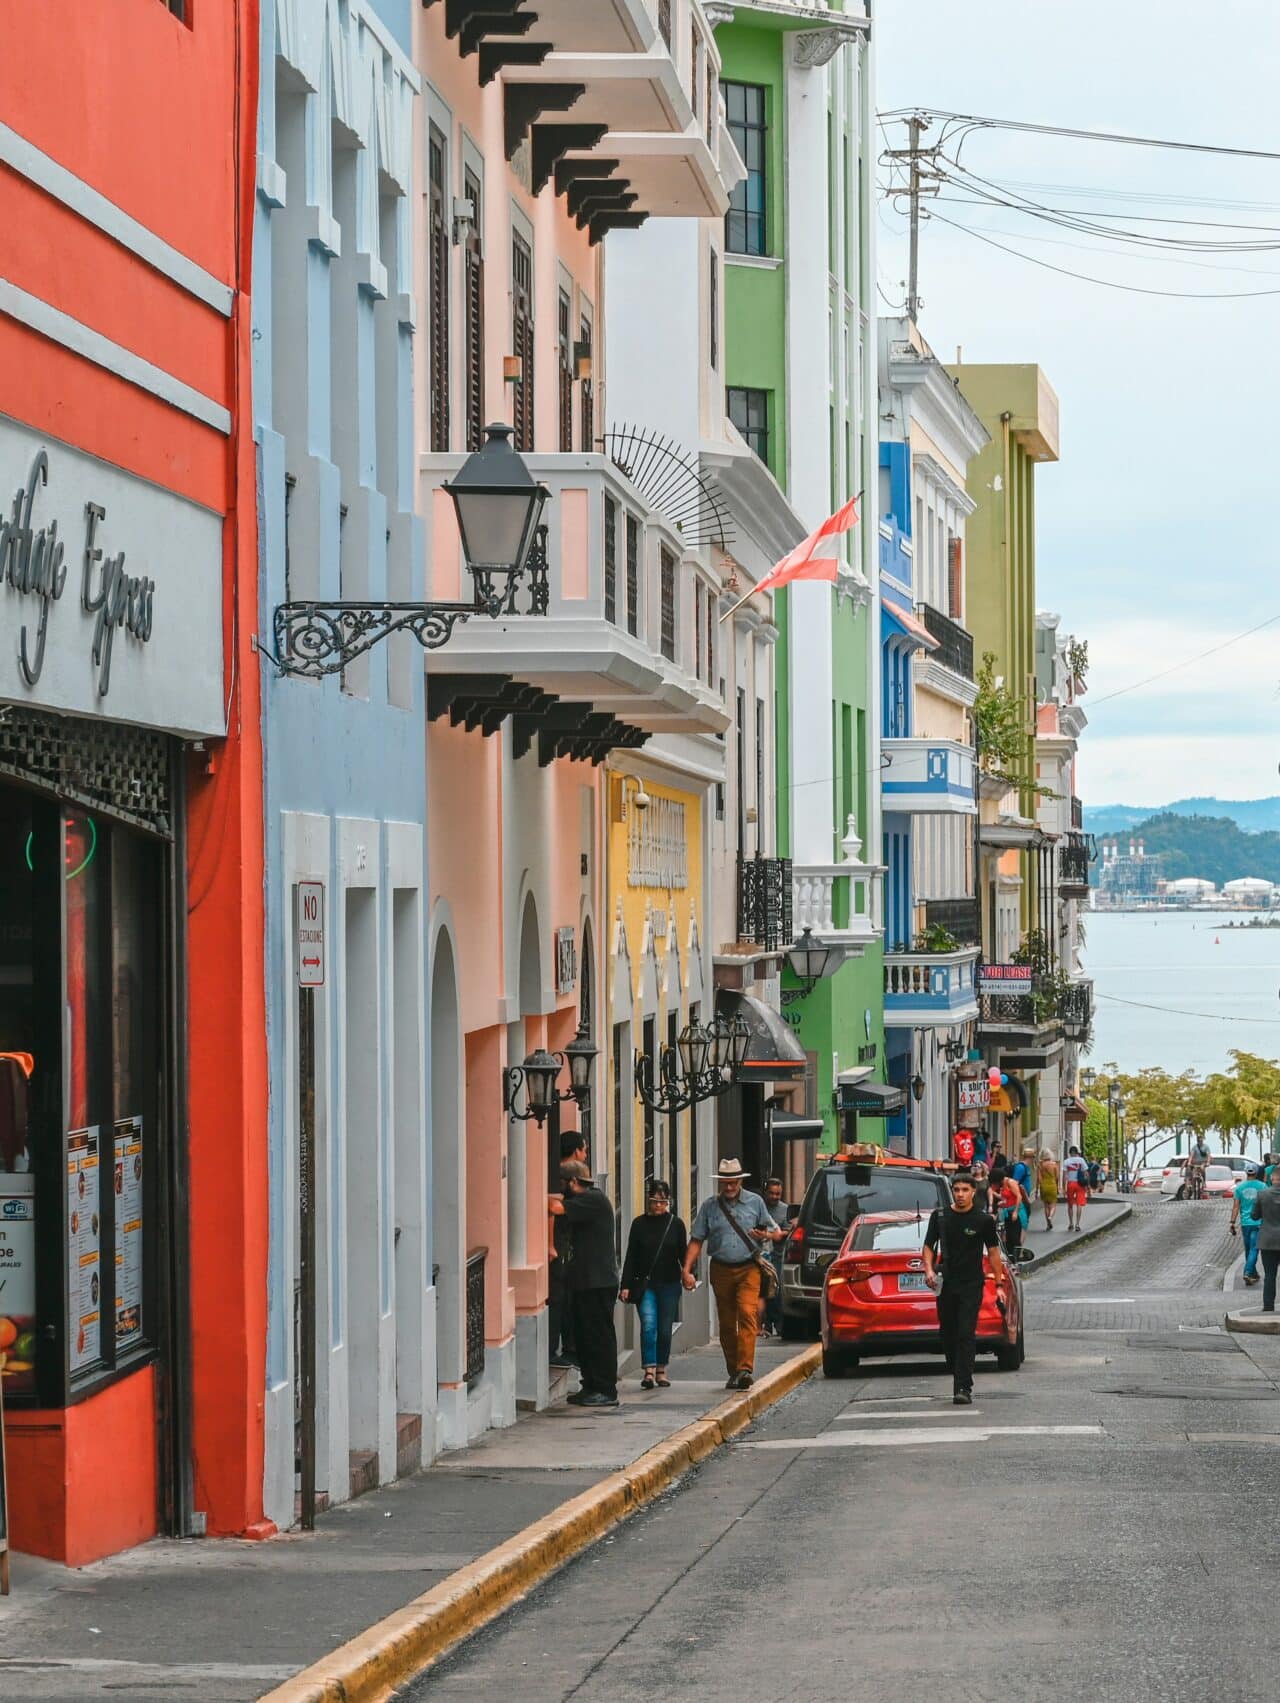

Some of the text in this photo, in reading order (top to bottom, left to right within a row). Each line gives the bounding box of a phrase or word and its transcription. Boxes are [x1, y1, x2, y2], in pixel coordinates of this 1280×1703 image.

[304, 896, 317, 920] NO
[984, 966, 1031, 978] FOR LEASE
